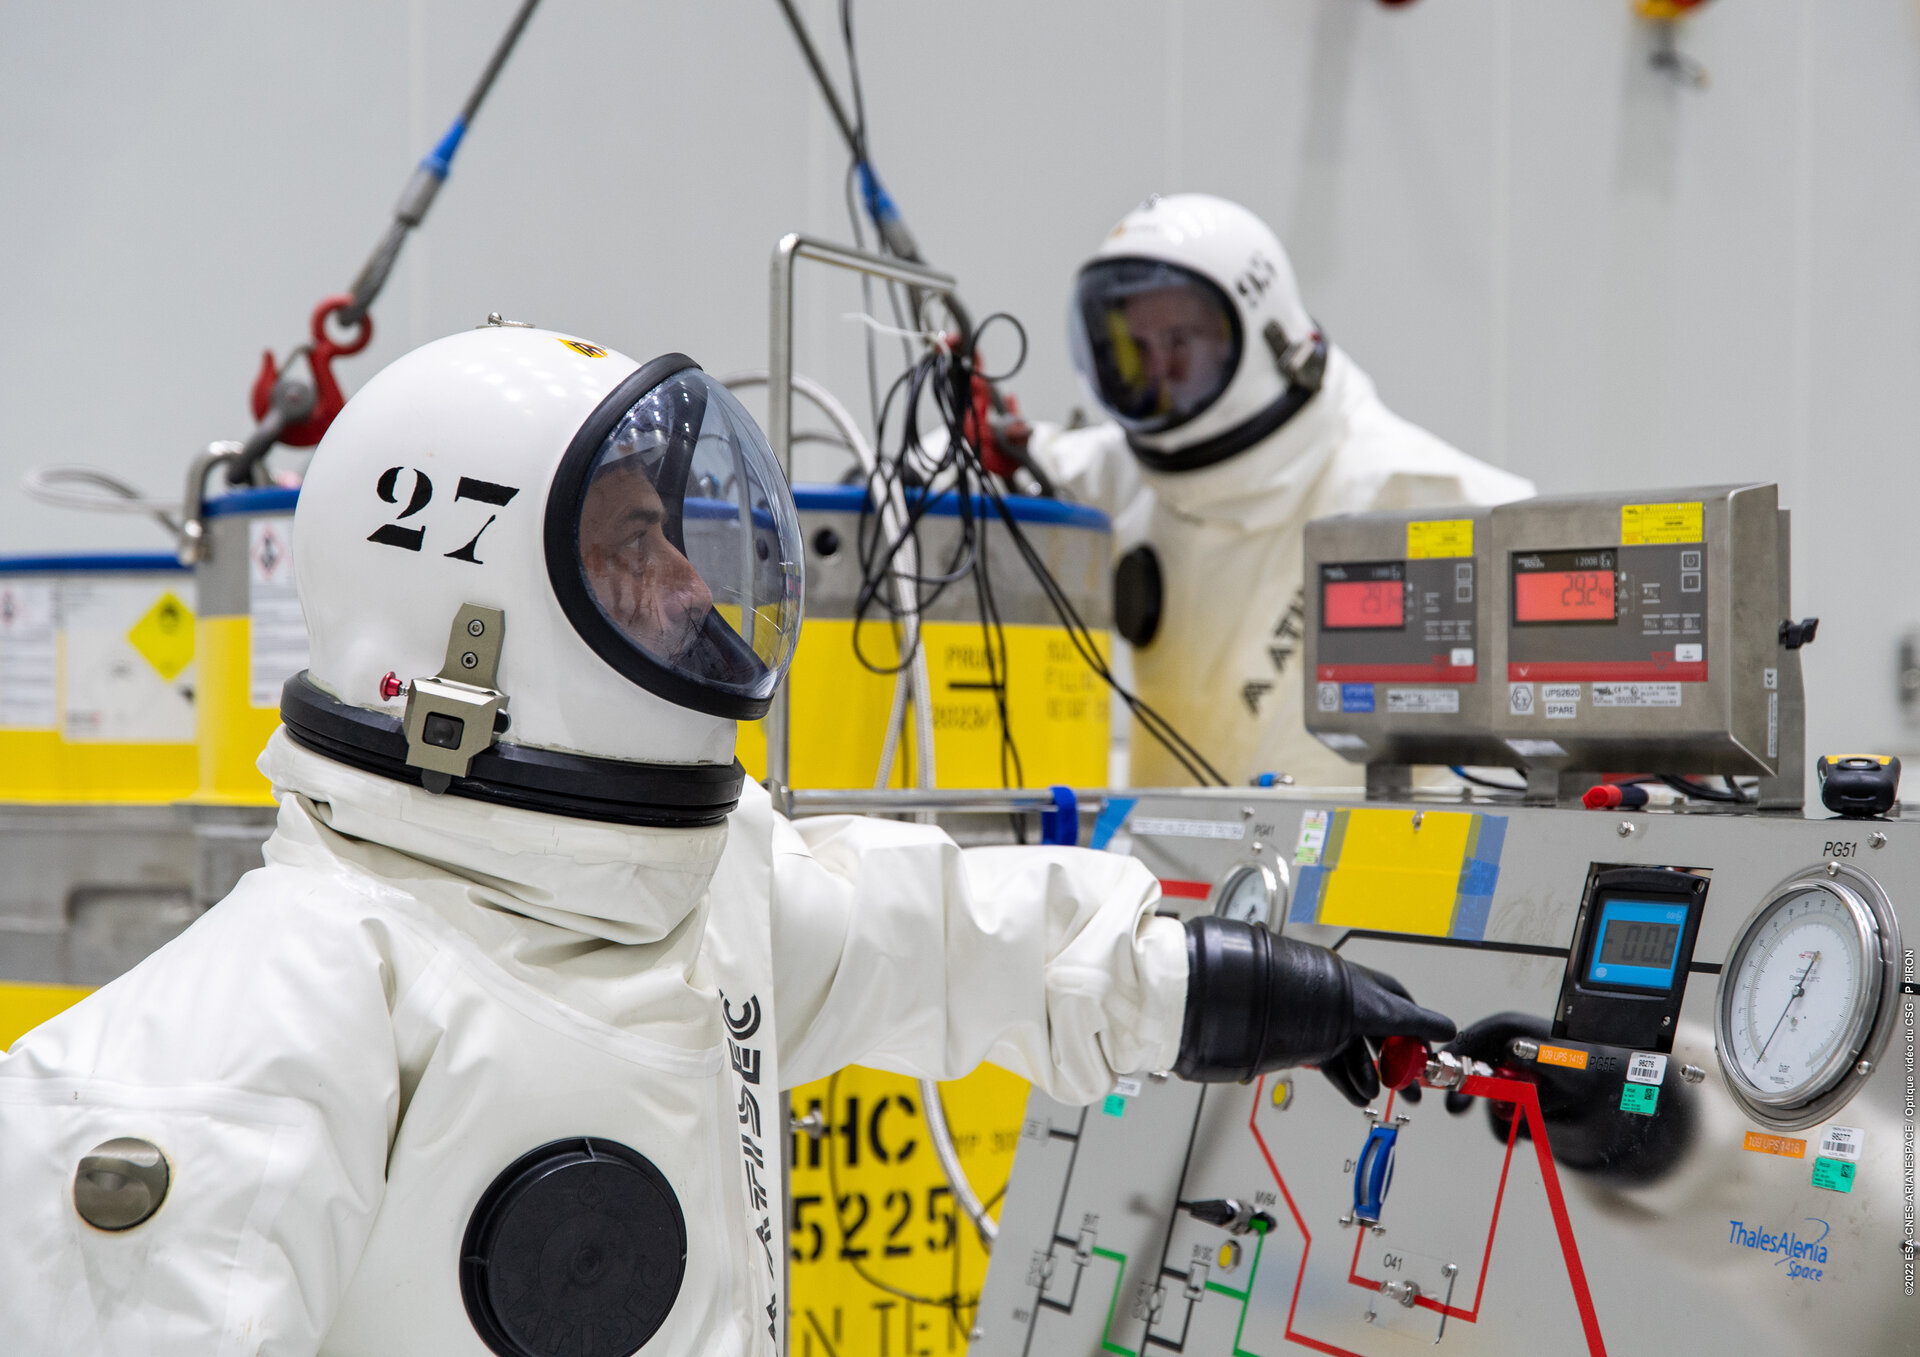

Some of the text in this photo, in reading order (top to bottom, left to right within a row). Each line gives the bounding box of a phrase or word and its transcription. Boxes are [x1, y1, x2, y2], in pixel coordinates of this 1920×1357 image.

[366, 466, 520, 565] 27
[1546, 704, 1575, 715] SPARE
[1823, 840, 1858, 859] PG51
[1554, 1050, 1568, 1063] UPS
[1763, 1137, 1780, 1152] UPS
[1729, 1220, 1828, 1264] ThalesAlenia
[1786, 1260, 1824, 1282] Space
